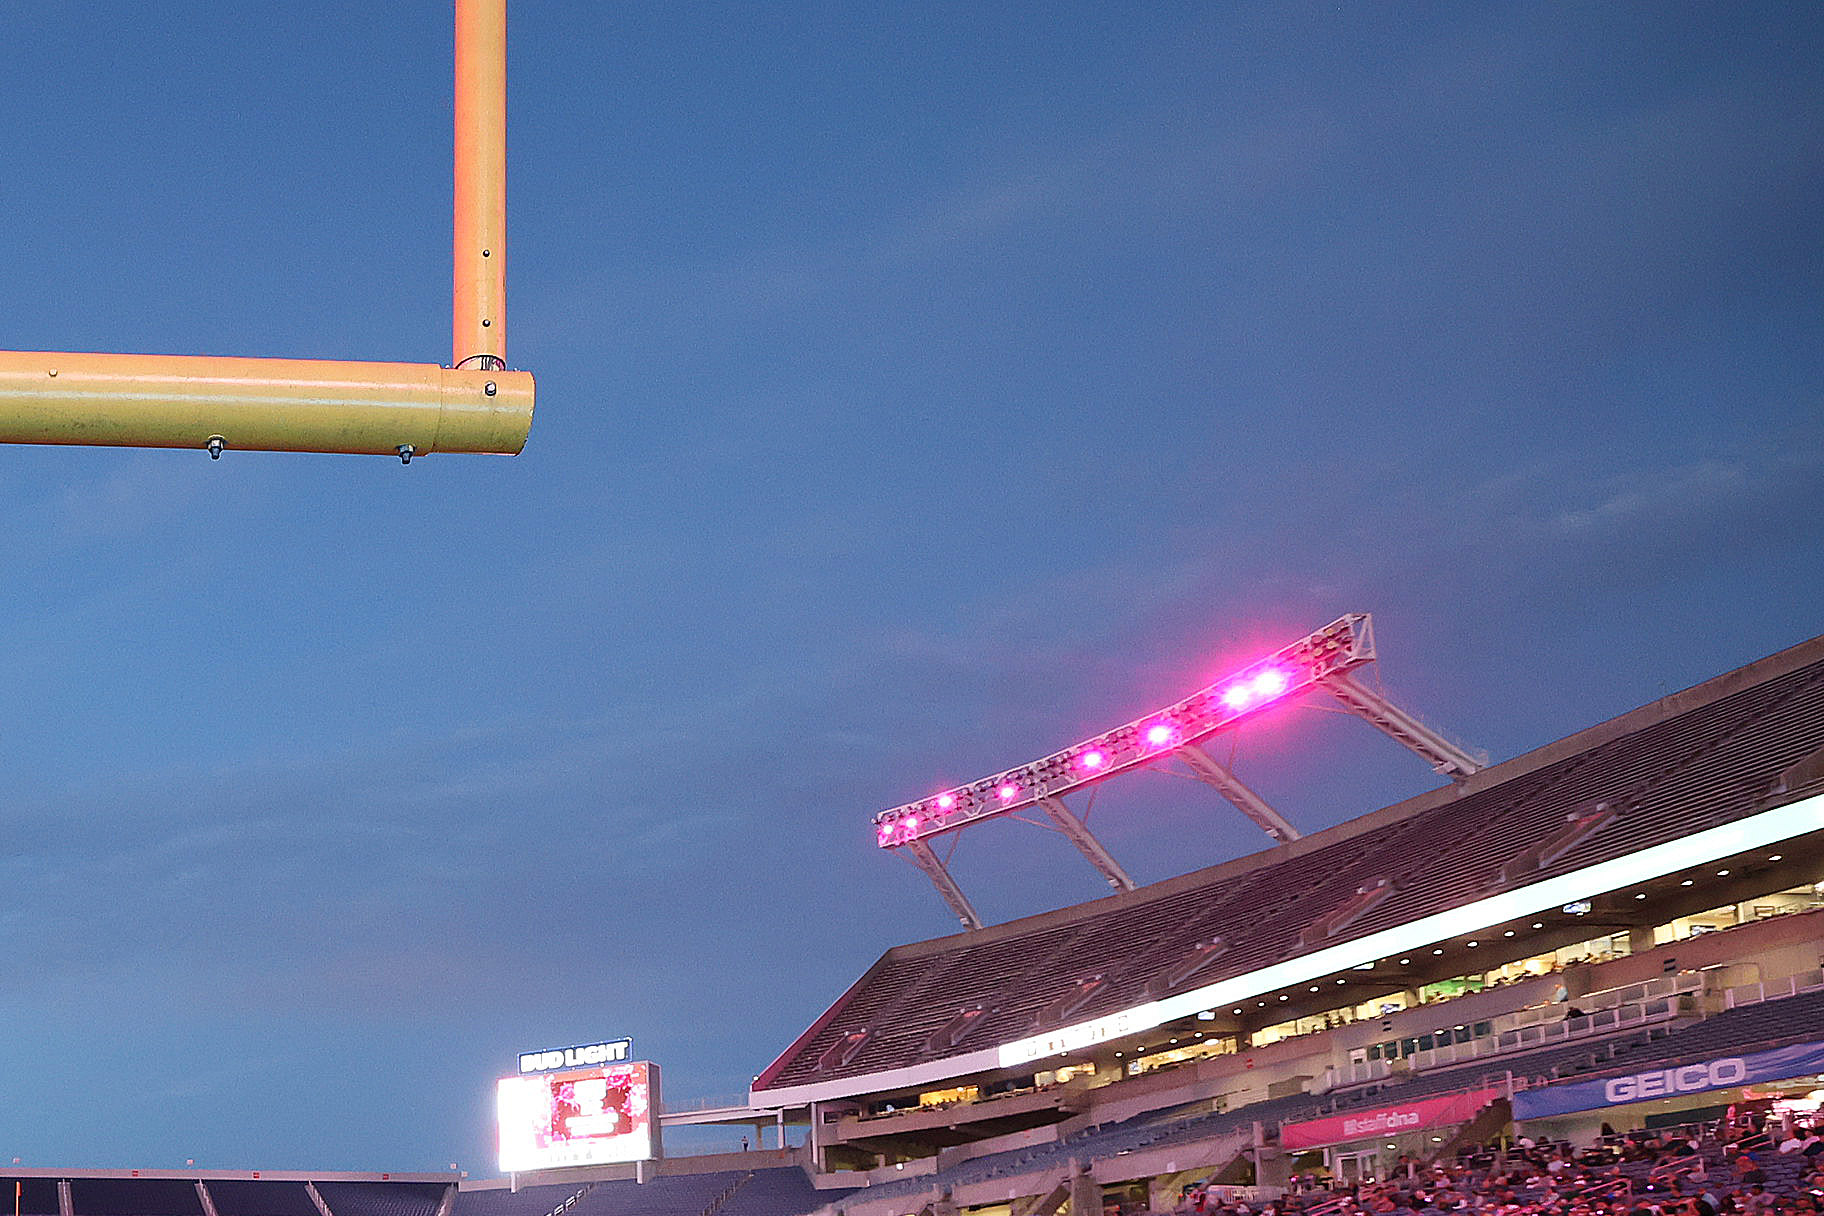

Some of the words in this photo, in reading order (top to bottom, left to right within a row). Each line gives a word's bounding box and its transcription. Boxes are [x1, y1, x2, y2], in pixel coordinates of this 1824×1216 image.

[520, 1050, 565, 1073] BUD
[564, 1041, 629, 1067] LIGHT
[1605, 1057, 1746, 1102] GEICO
